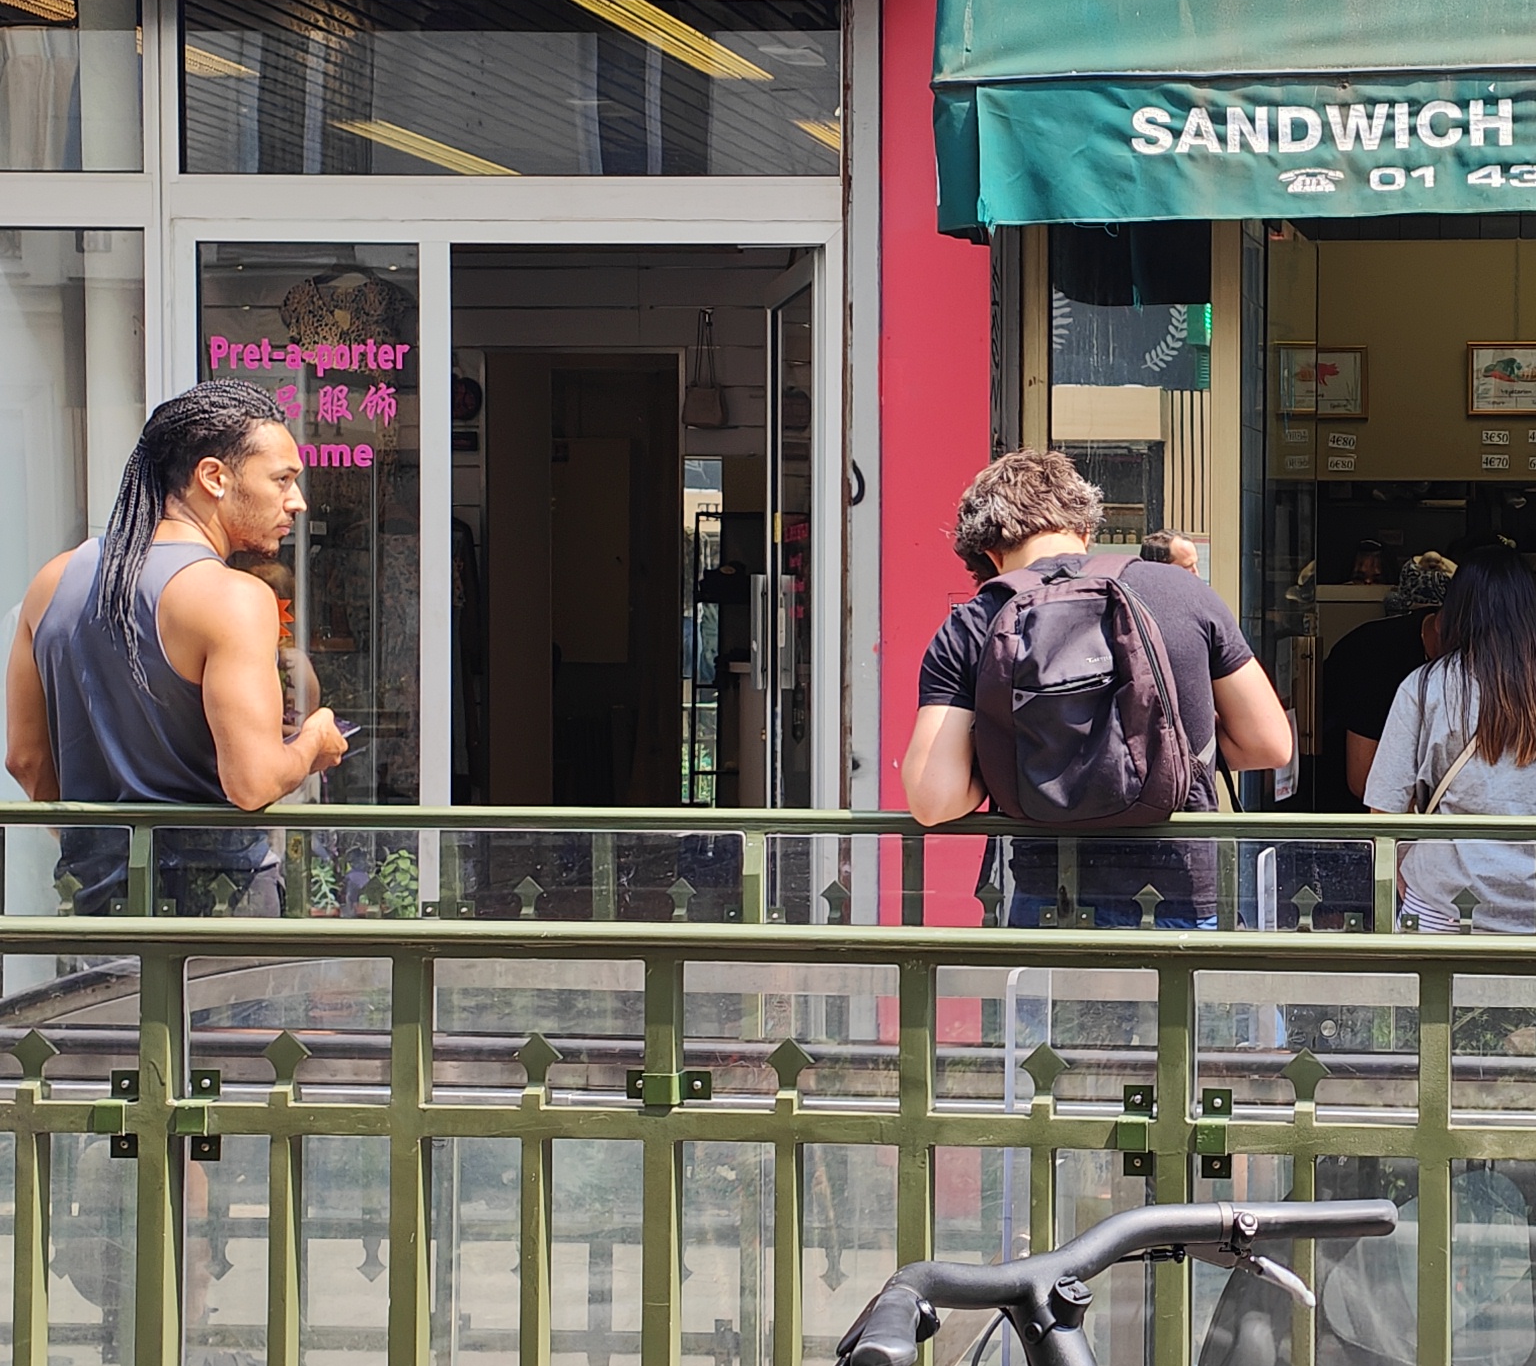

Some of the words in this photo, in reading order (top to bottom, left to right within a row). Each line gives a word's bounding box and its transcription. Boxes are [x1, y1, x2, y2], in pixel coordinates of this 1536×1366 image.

[1130, 99, 1513, 157] SANDWICH
[1369, 164, 1435, 191] 01
[1329, 435, 1356, 448] 4€80
[1482, 432, 1509, 444] 3€50
[1329, 459, 1353, 470] 6€80
[1482, 456, 1509, 468] 4€70
